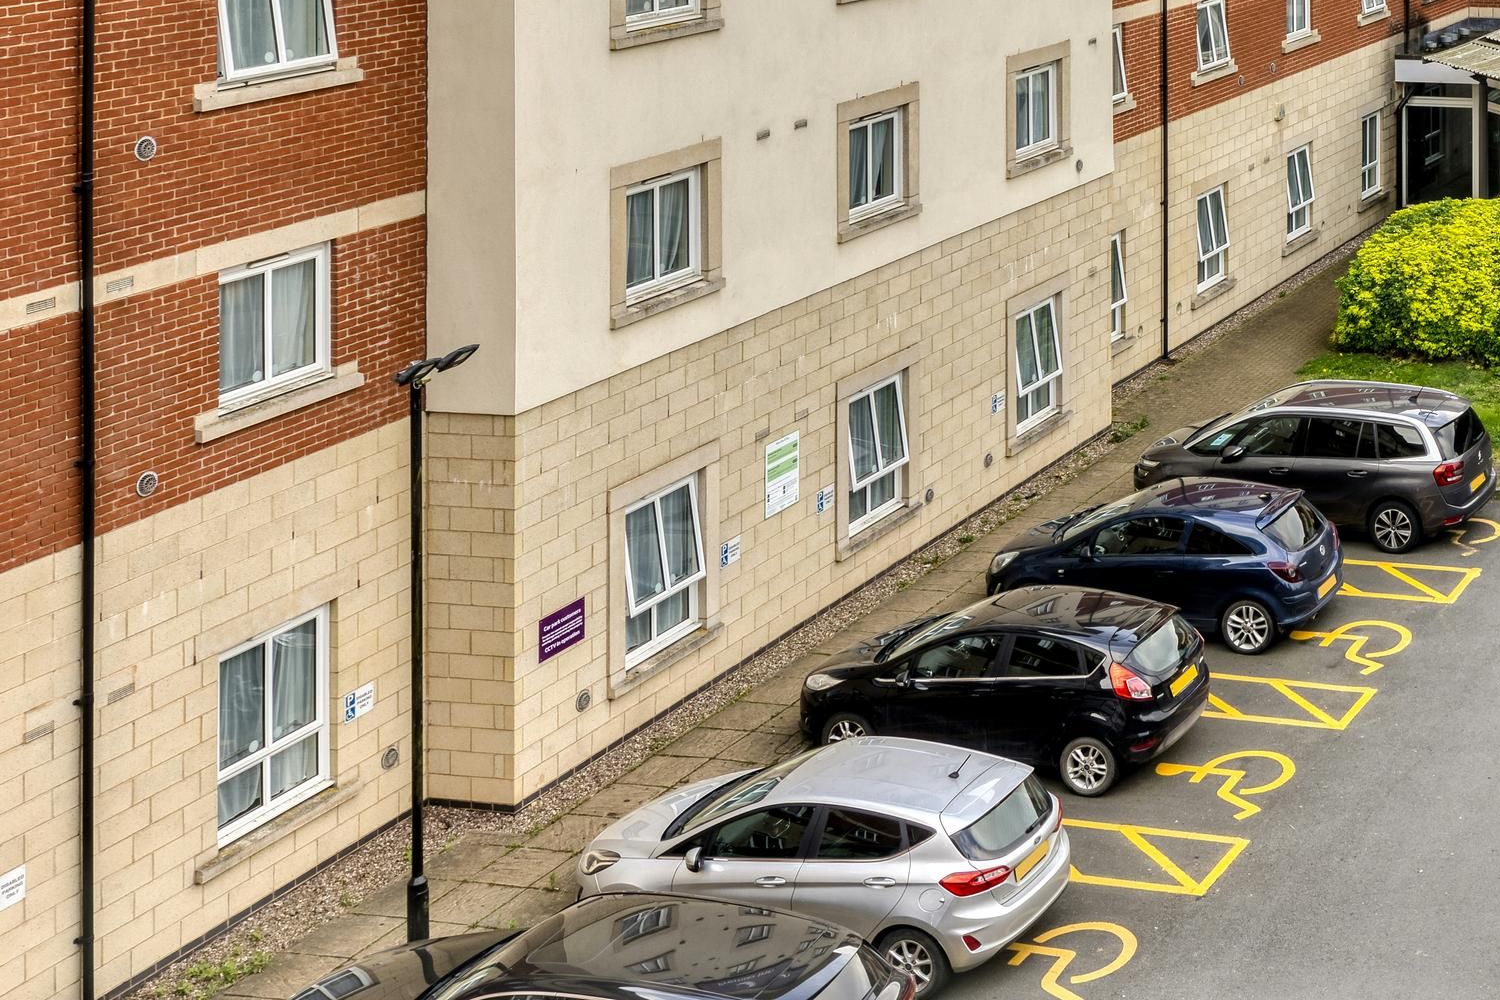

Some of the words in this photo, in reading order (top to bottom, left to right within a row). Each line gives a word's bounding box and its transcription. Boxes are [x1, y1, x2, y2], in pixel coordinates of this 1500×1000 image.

[560, 608, 581, 622] customers
[544, 642, 557, 653] CCTV
[561, 630, 581, 644] operation
